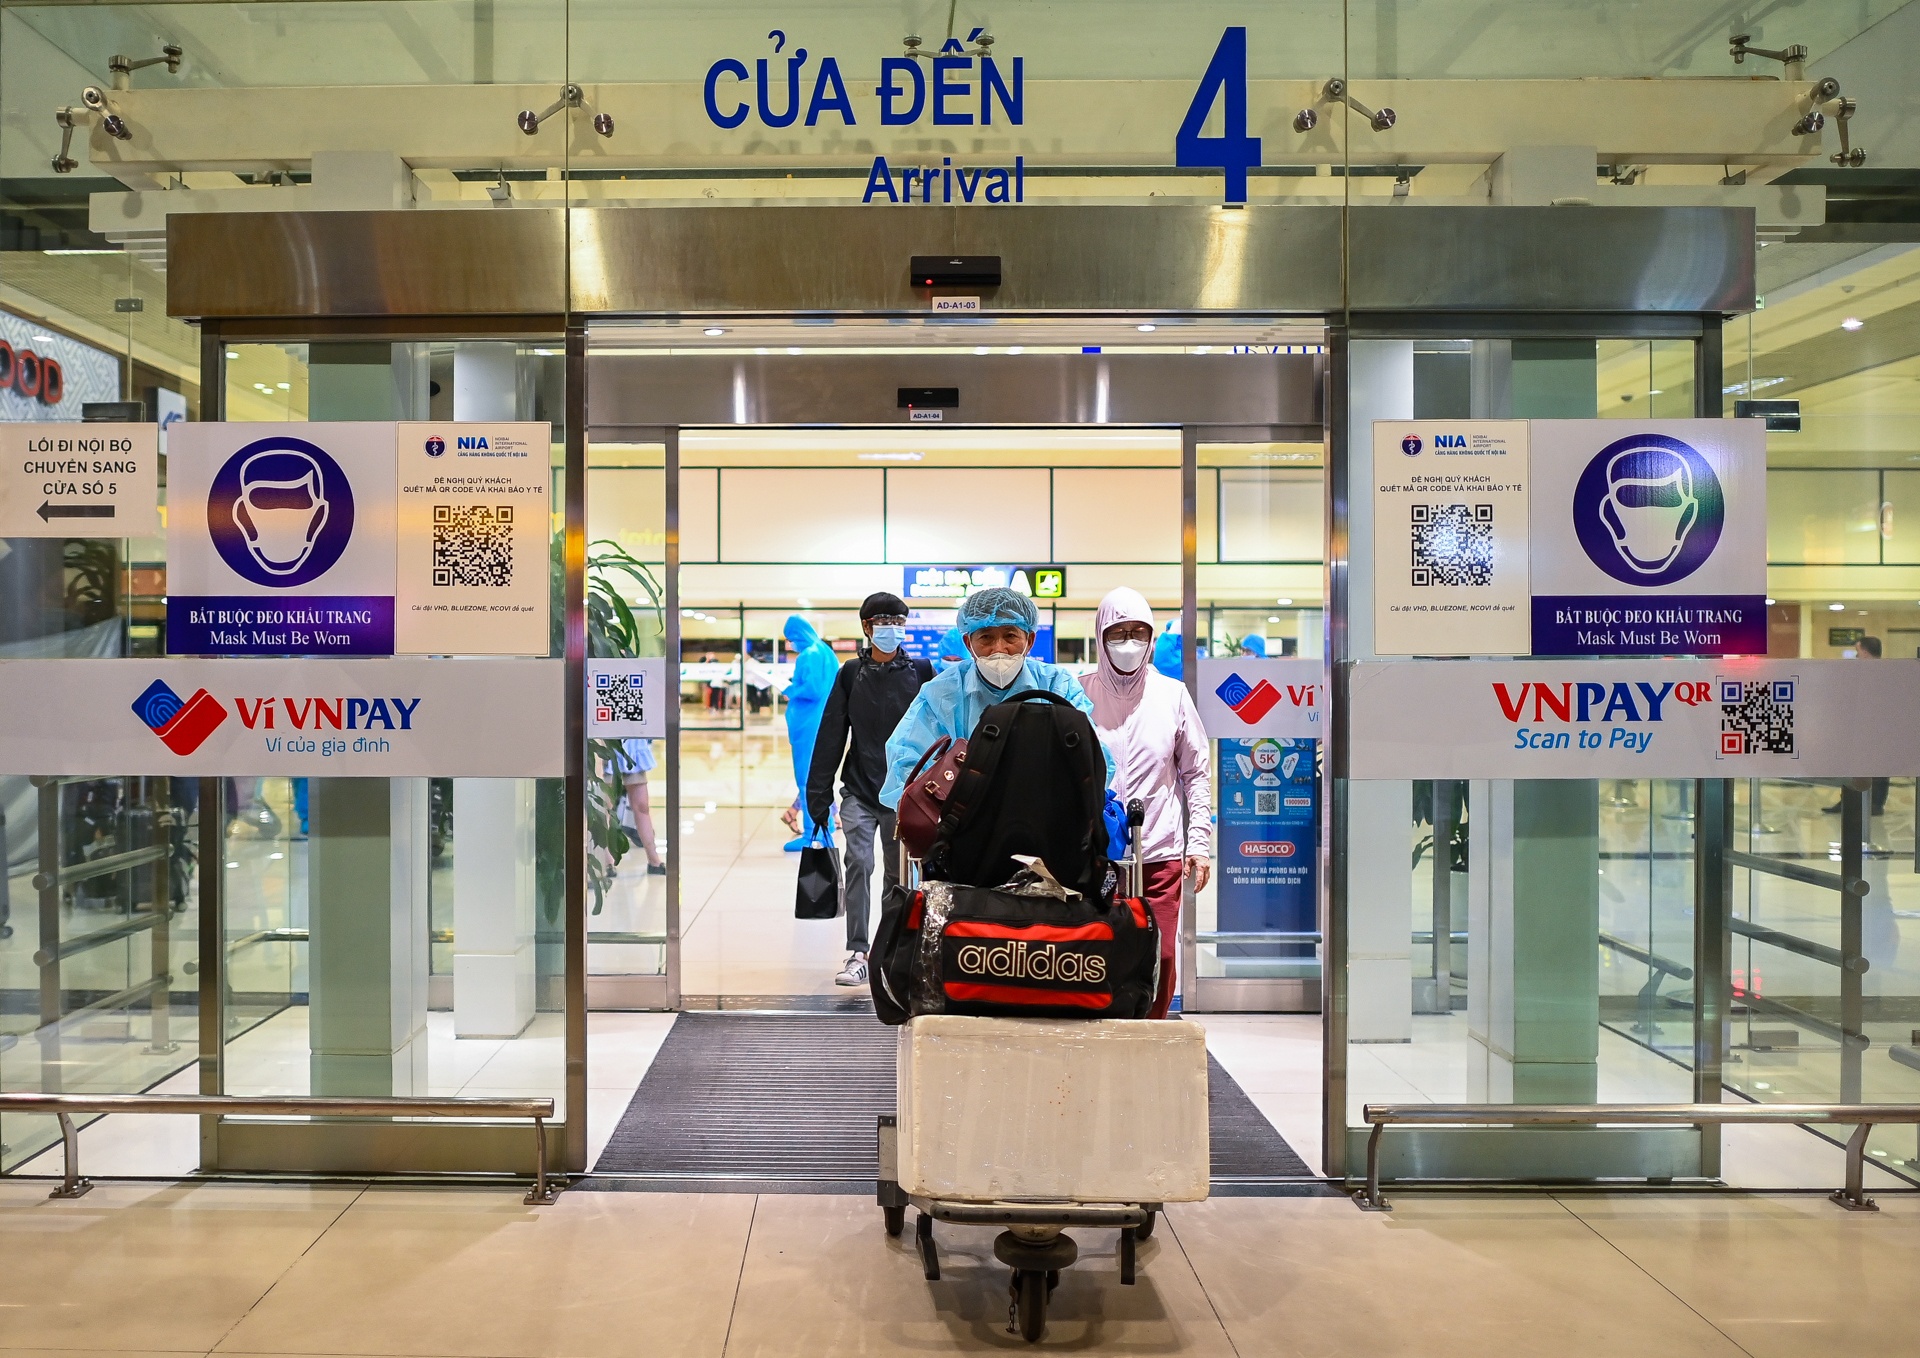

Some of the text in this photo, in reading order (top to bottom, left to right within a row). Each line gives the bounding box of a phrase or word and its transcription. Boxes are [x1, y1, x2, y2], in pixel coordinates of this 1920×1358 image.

[703, 27, 1024, 129] CỬA ĐẾN
[1175, 26, 1262, 203] 4
[861, 156, 1024, 203] Arrival
[29, 437, 132, 454] LỐI ĐI NỘI BỘ
[458, 436, 489, 450] NIA
[1435, 435, 1466, 448] NIA
[24, 458, 136, 473] CHUYỂN SANG
[43, 480, 117, 494] CỬA SỐ 5
[190, 606, 372, 627] BẮT BUỘC ĐEO KHẨU TRANG
[1556, 606, 1742, 626] BẮT BUỘC ĐEO KHẨU TRANG
[210, 630, 350, 645] Mask Must Be Worn
[1577, 630, 1721, 645] Mask Must Be Worn
[1286, 684, 1314, 706] Ví
[234, 696, 422, 730] Ví VNPAY
[1308, 712, 1319, 722] Ví
[266, 736, 390, 756] Ví của gia đình
[1515, 728, 1653, 753] Scan to Pay
[1260, 754, 1276, 764] 5K
[1246, 844, 1289, 854] HASOCO
[958, 941, 1106, 982] adidas
